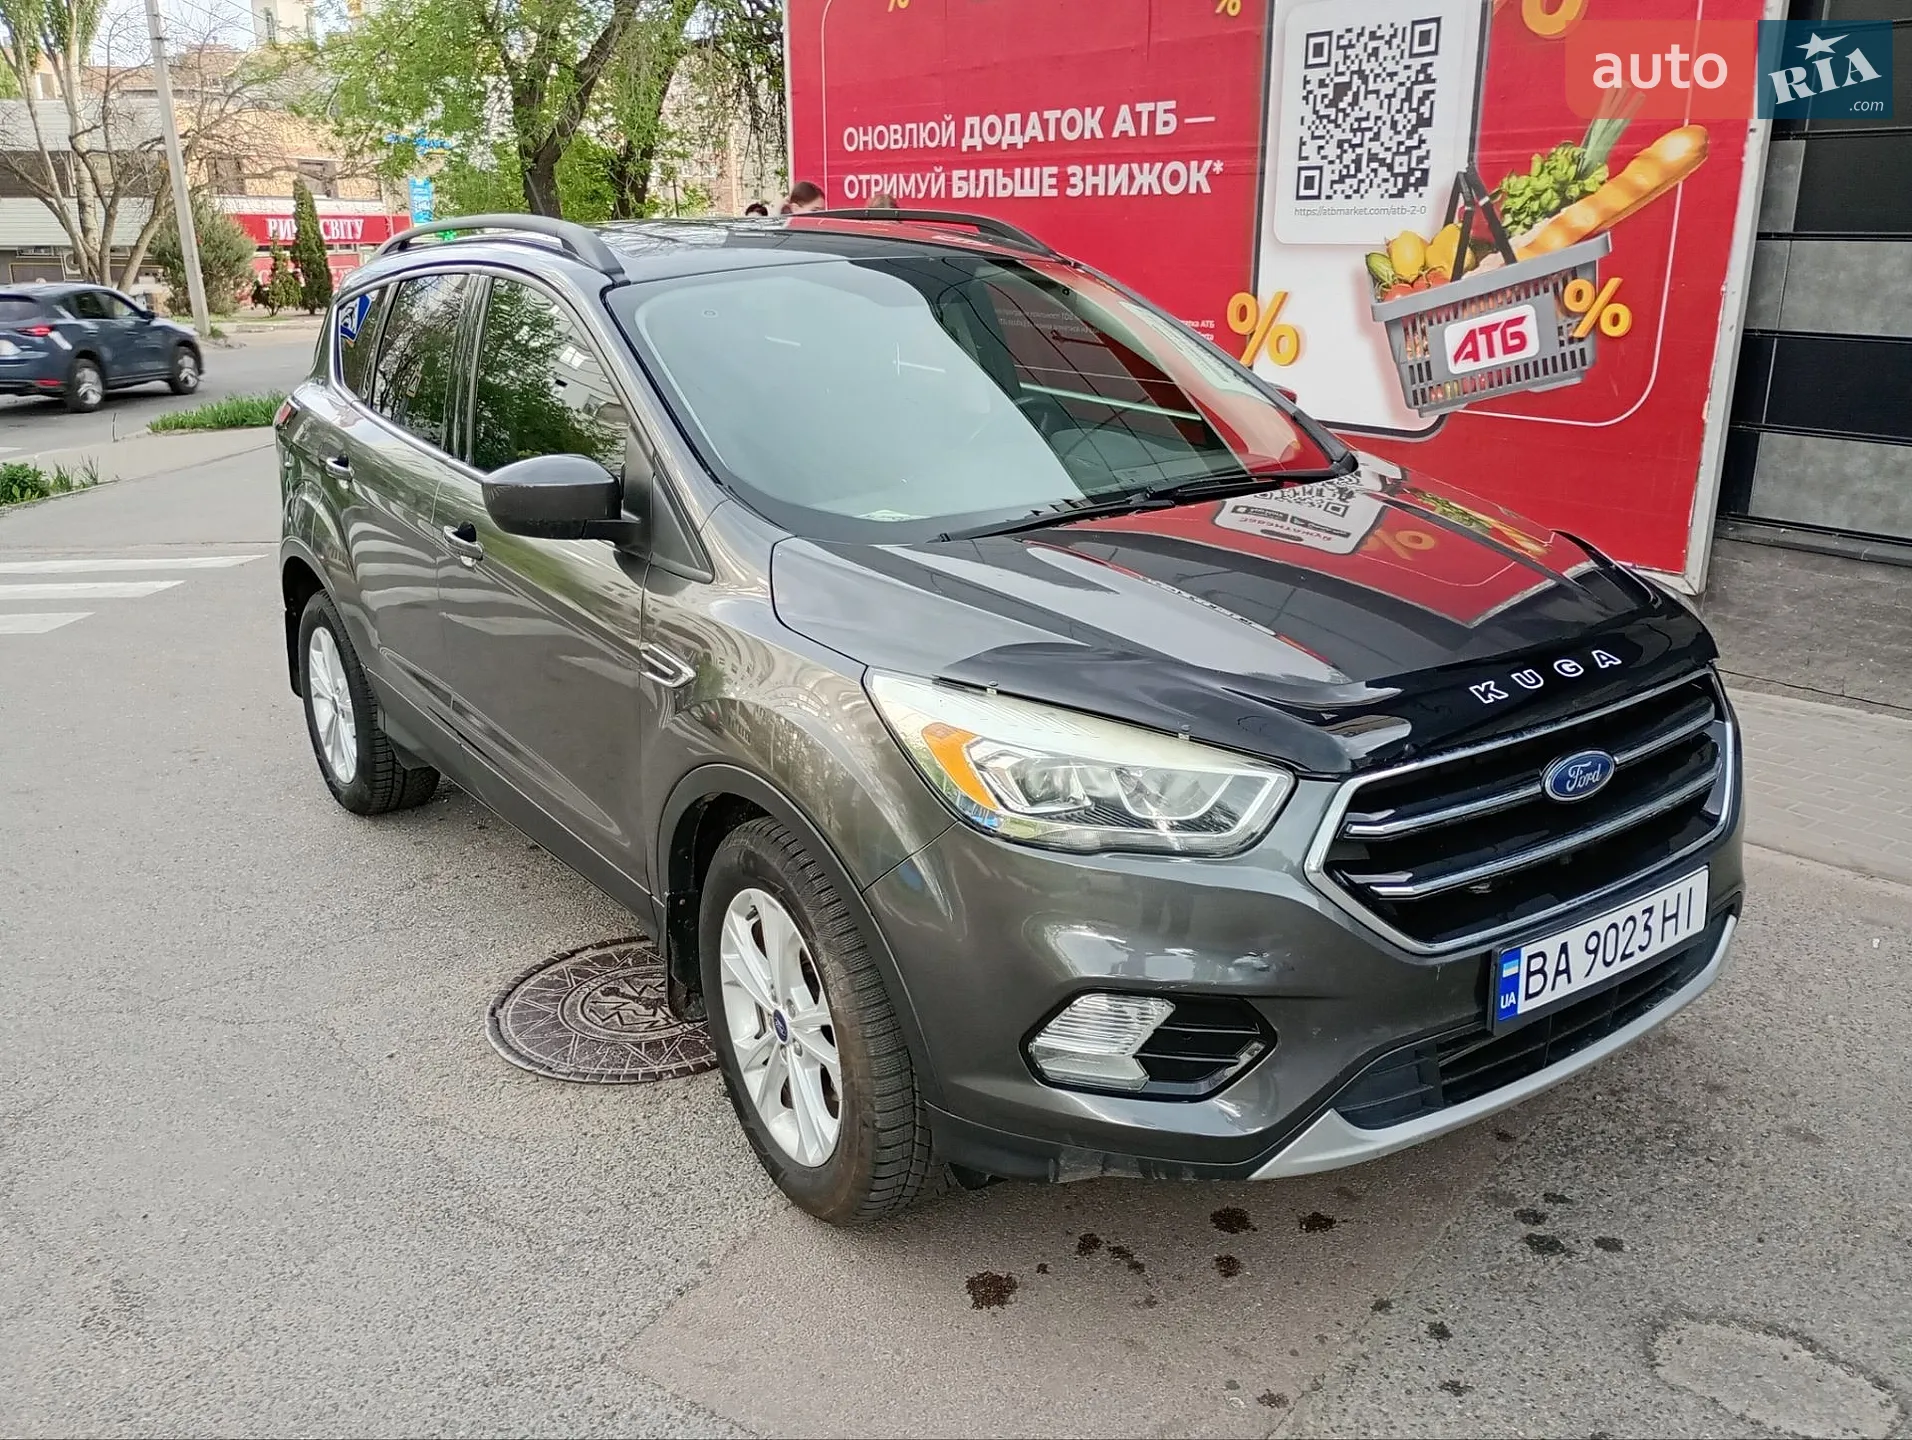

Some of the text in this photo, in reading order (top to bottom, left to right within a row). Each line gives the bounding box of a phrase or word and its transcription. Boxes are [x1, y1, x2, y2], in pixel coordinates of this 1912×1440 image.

[843, 114, 956, 152] ОНОВЛЮЙ
[961, 105, 1104, 152] ДОДАТОК
[1111, 100, 1178, 139] АТБ
[843, 165, 946, 199] ОТРИМУЙ
[951, 166, 1059, 199] БІЛЬШЕ
[1294, 205, 1427, 217] https://atbmarket.com/atb-2-0
[320, 218, 365, 241] СВІТУ
[1453, 314, 1528, 365] АТБ
[1468, 649, 1623, 704] KUGA
[1565, 760, 1602, 792] Ford
[1524, 887, 1694, 1002] BA 9023 HI
[1500, 994, 1517, 1009] UA
